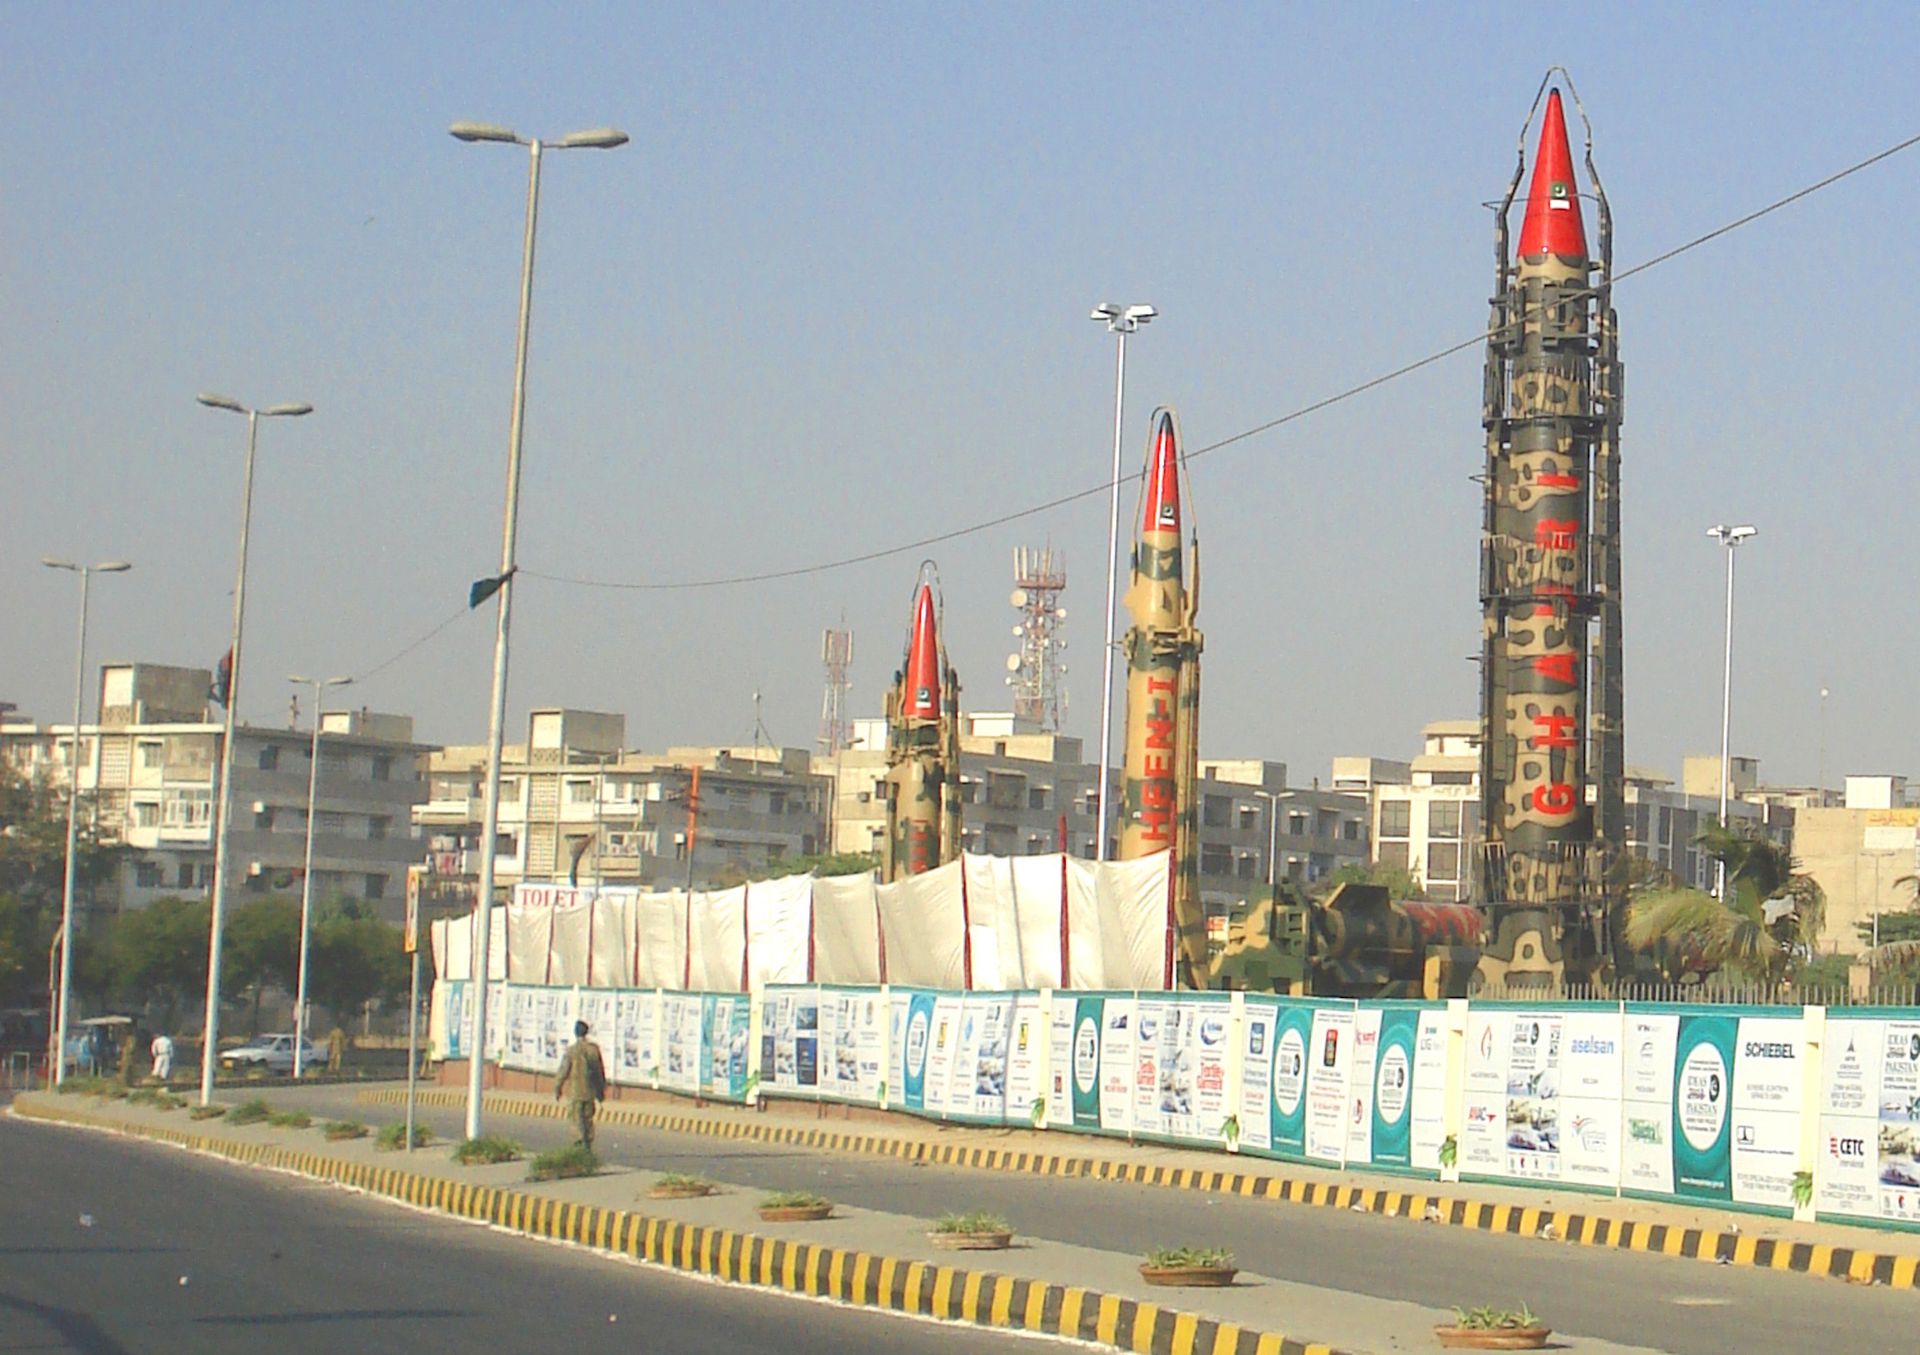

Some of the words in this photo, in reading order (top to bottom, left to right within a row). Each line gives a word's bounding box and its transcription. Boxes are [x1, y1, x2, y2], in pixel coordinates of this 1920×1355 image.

[1571, 1036, 1614, 1054] aselsan
[1745, 1041, 1795, 1059] SCHIEBEL
[1840, 1138, 1865, 1156] CETC
